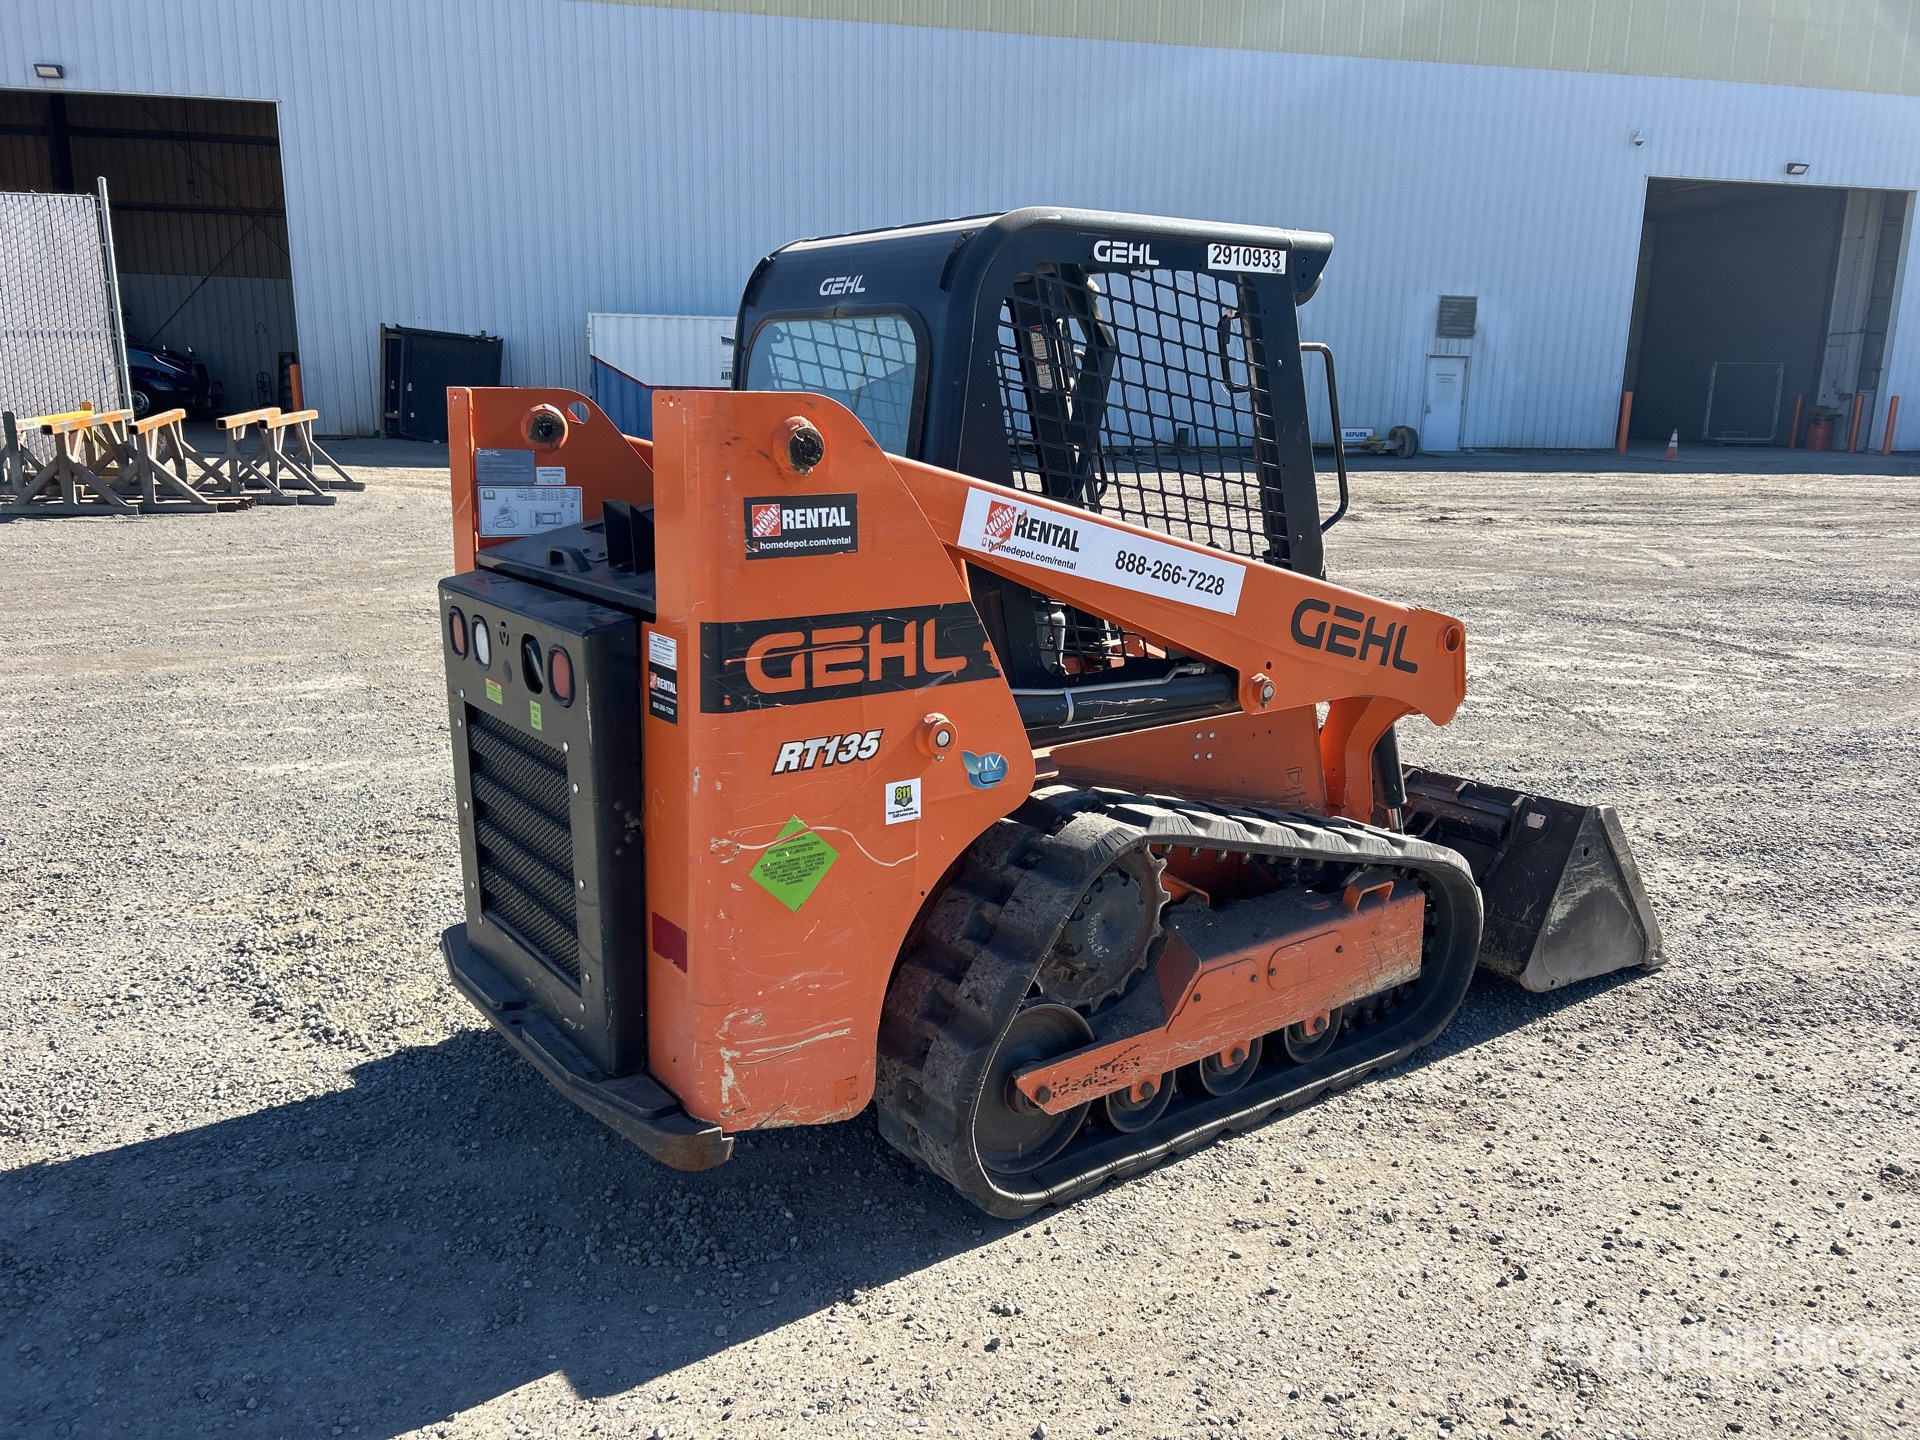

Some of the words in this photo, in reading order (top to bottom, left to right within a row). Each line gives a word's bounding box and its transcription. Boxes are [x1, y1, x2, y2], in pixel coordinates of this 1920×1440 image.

[1094, 240, 1159, 265] GEHL
[1212, 245, 1281, 268] 2910933
[820, 275, 866, 296] GEHL
[753, 505, 780, 536] HOME
[782, 507, 850, 529] RENTAL
[986, 505, 1015, 534] HOME
[760, 536, 851, 549] homedepot.com/rental
[1014, 515, 1079, 552] RENTAL
[1115, 550, 1225, 596] 888-266-7228
[1291, 598, 1418, 674] GEHL
[745, 618, 968, 694] GEHL
[772, 728, 884, 775] RT135
[896, 786, 911, 800] 811
